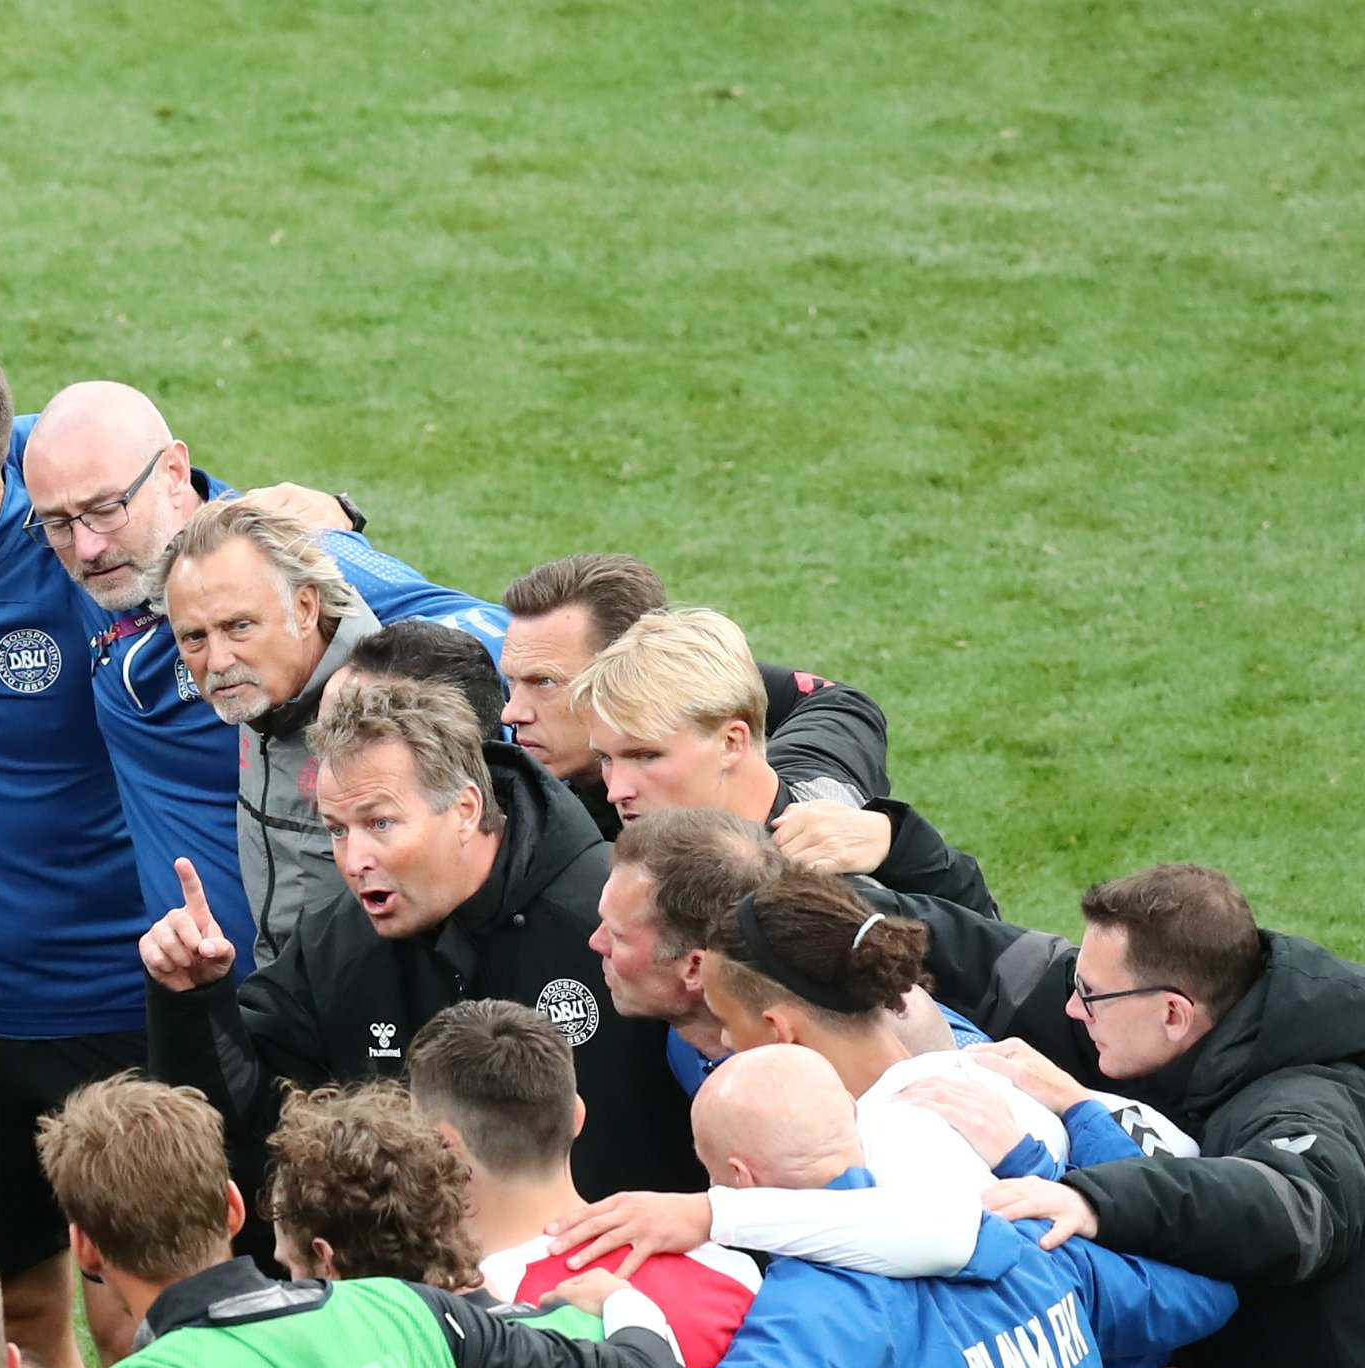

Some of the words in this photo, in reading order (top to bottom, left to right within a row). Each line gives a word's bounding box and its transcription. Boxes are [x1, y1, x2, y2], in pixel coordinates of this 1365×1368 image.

[8, 649, 47, 670] DBU
[46, 645, 59, 681] UNION
[18, 680, 45, 691] 1889
[548, 1000, 587, 1023] DBU
[585, 995, 597, 1032] UNION
[566, 1032, 587, 1044] 889
[368, 1046, 402, 1058] hummel
